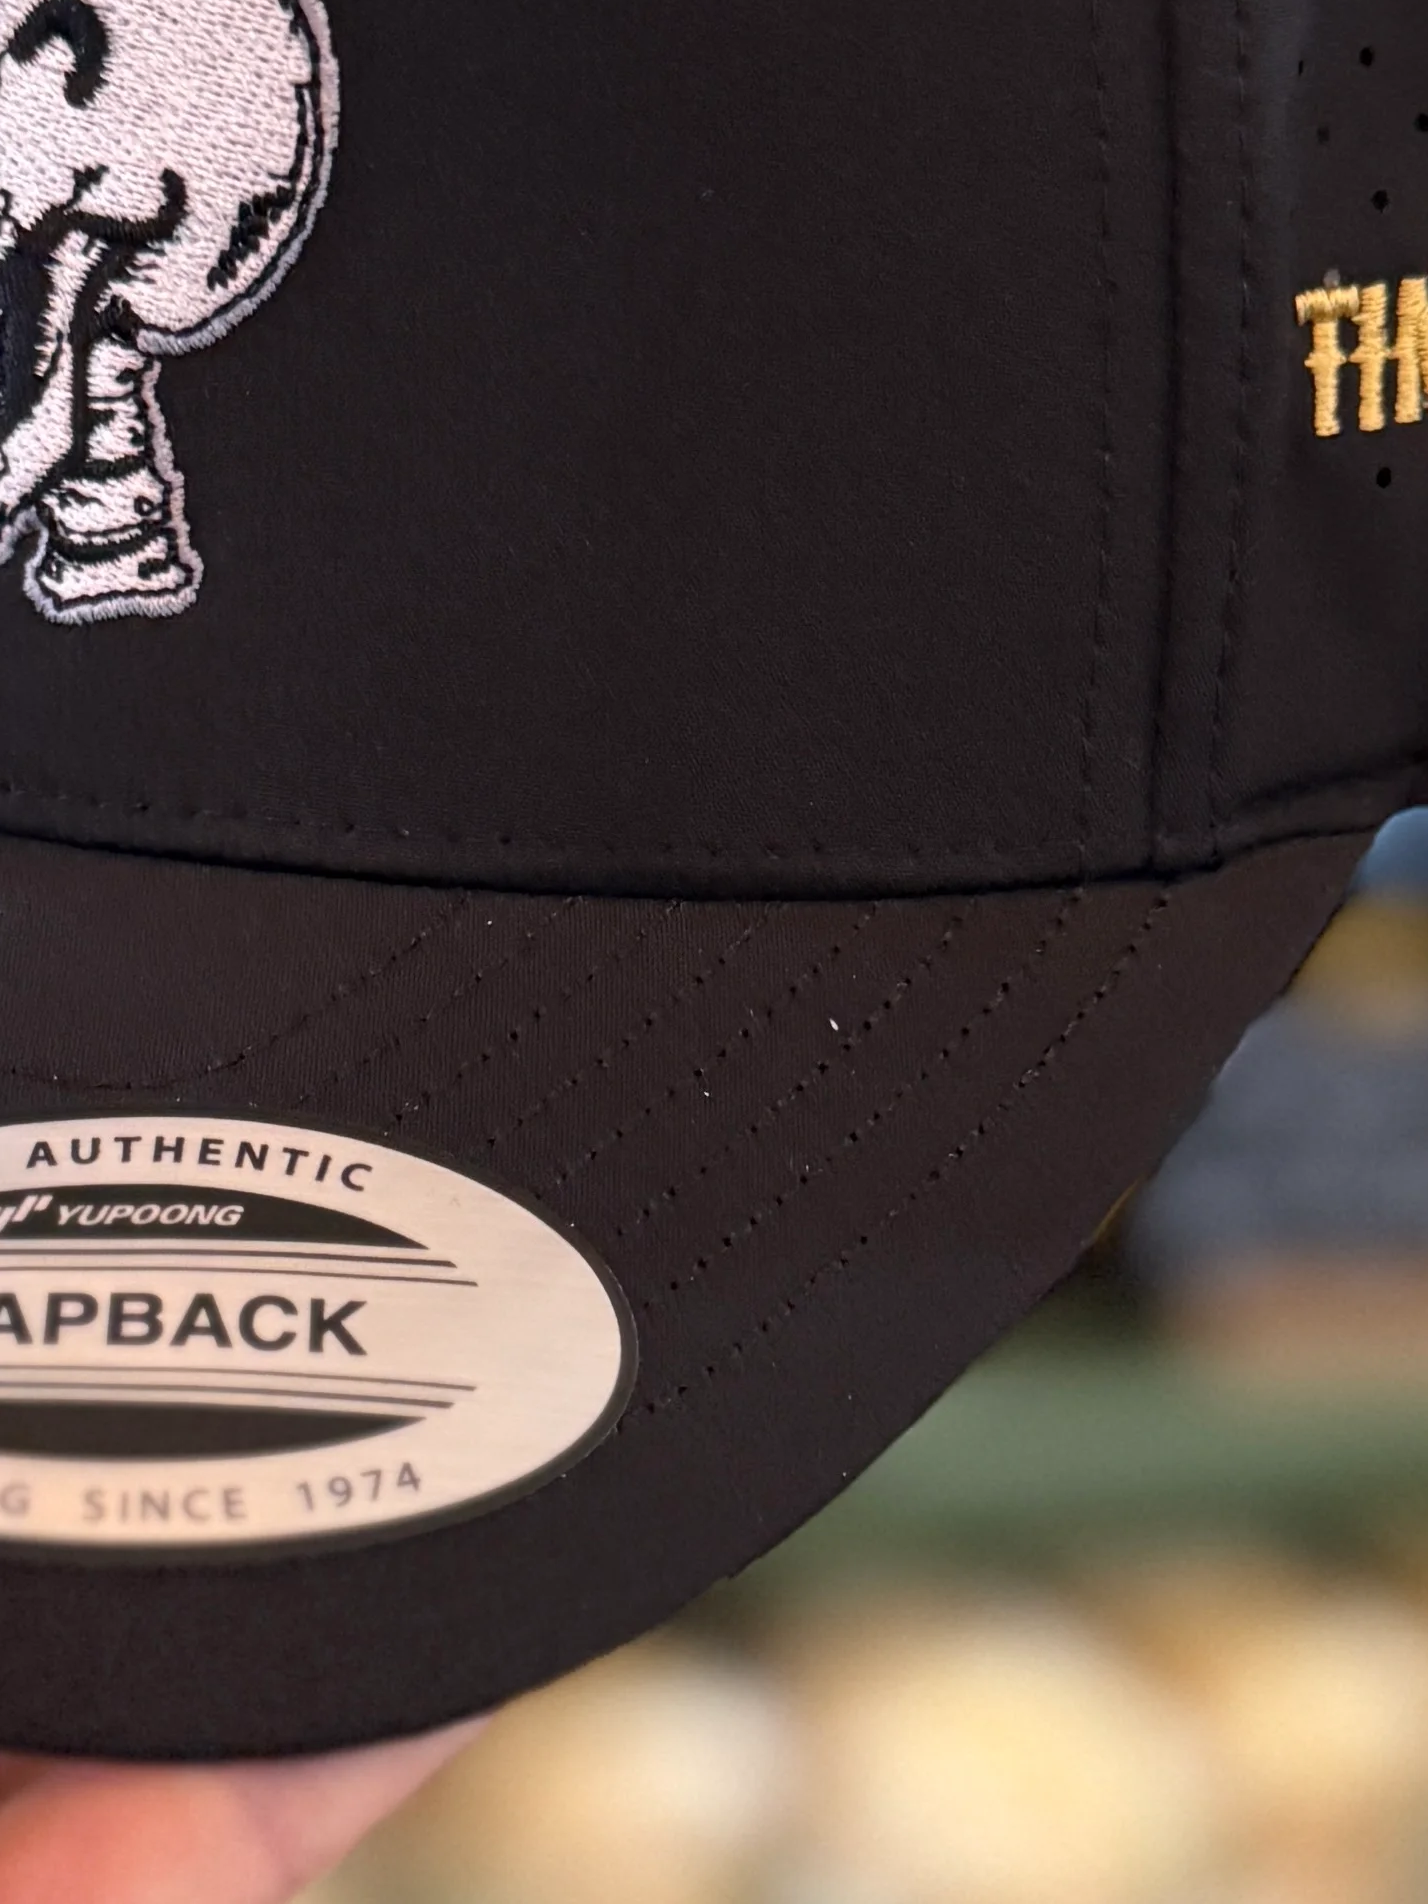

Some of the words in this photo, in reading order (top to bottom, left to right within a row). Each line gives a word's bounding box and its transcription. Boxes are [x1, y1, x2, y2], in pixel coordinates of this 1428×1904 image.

[25, 1135, 374, 1193] AUTHENTIC
[57, 1203, 245, 1227] YUPOONG
[82, 1487, 248, 1522] SINCE
[295, 1462, 422, 1512] 1974
